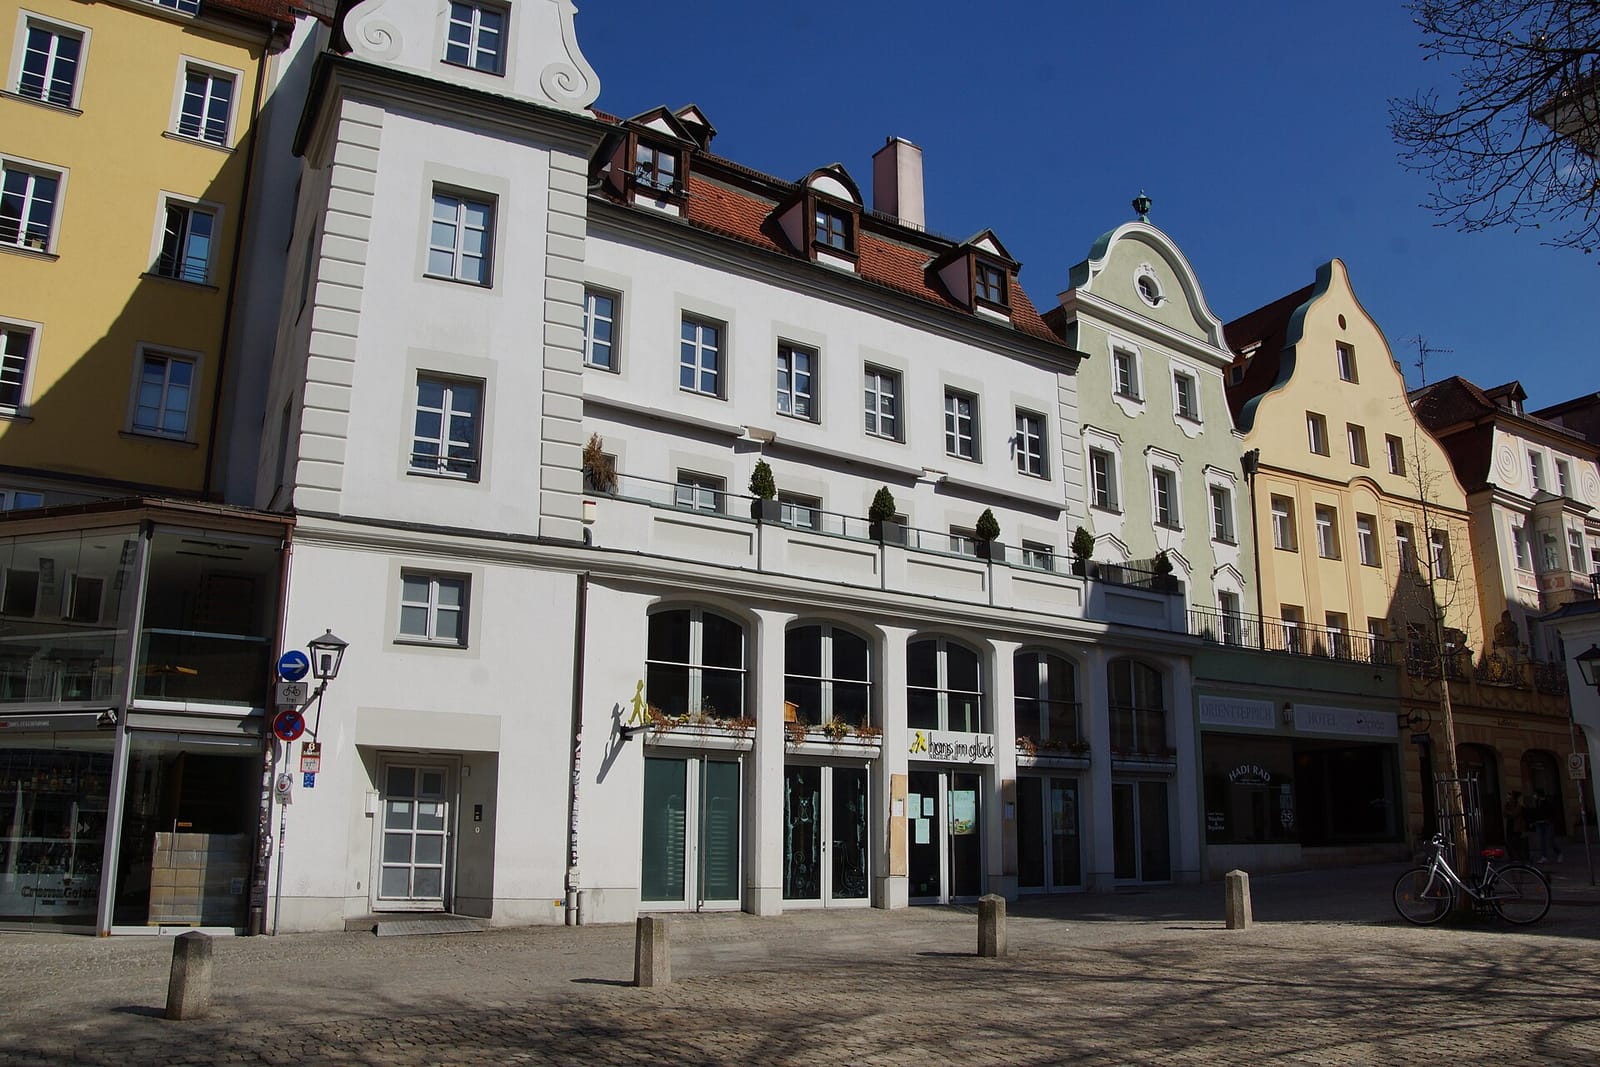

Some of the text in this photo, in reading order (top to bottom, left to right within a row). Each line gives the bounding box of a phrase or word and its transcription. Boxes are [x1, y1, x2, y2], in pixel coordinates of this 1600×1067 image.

[1201, 702, 1272, 721] ORIENTTEPPICH
[929, 732, 953, 756] hans
[969, 735, 993, 763] glück
[1228, 764, 1271, 782] HADI RAD
